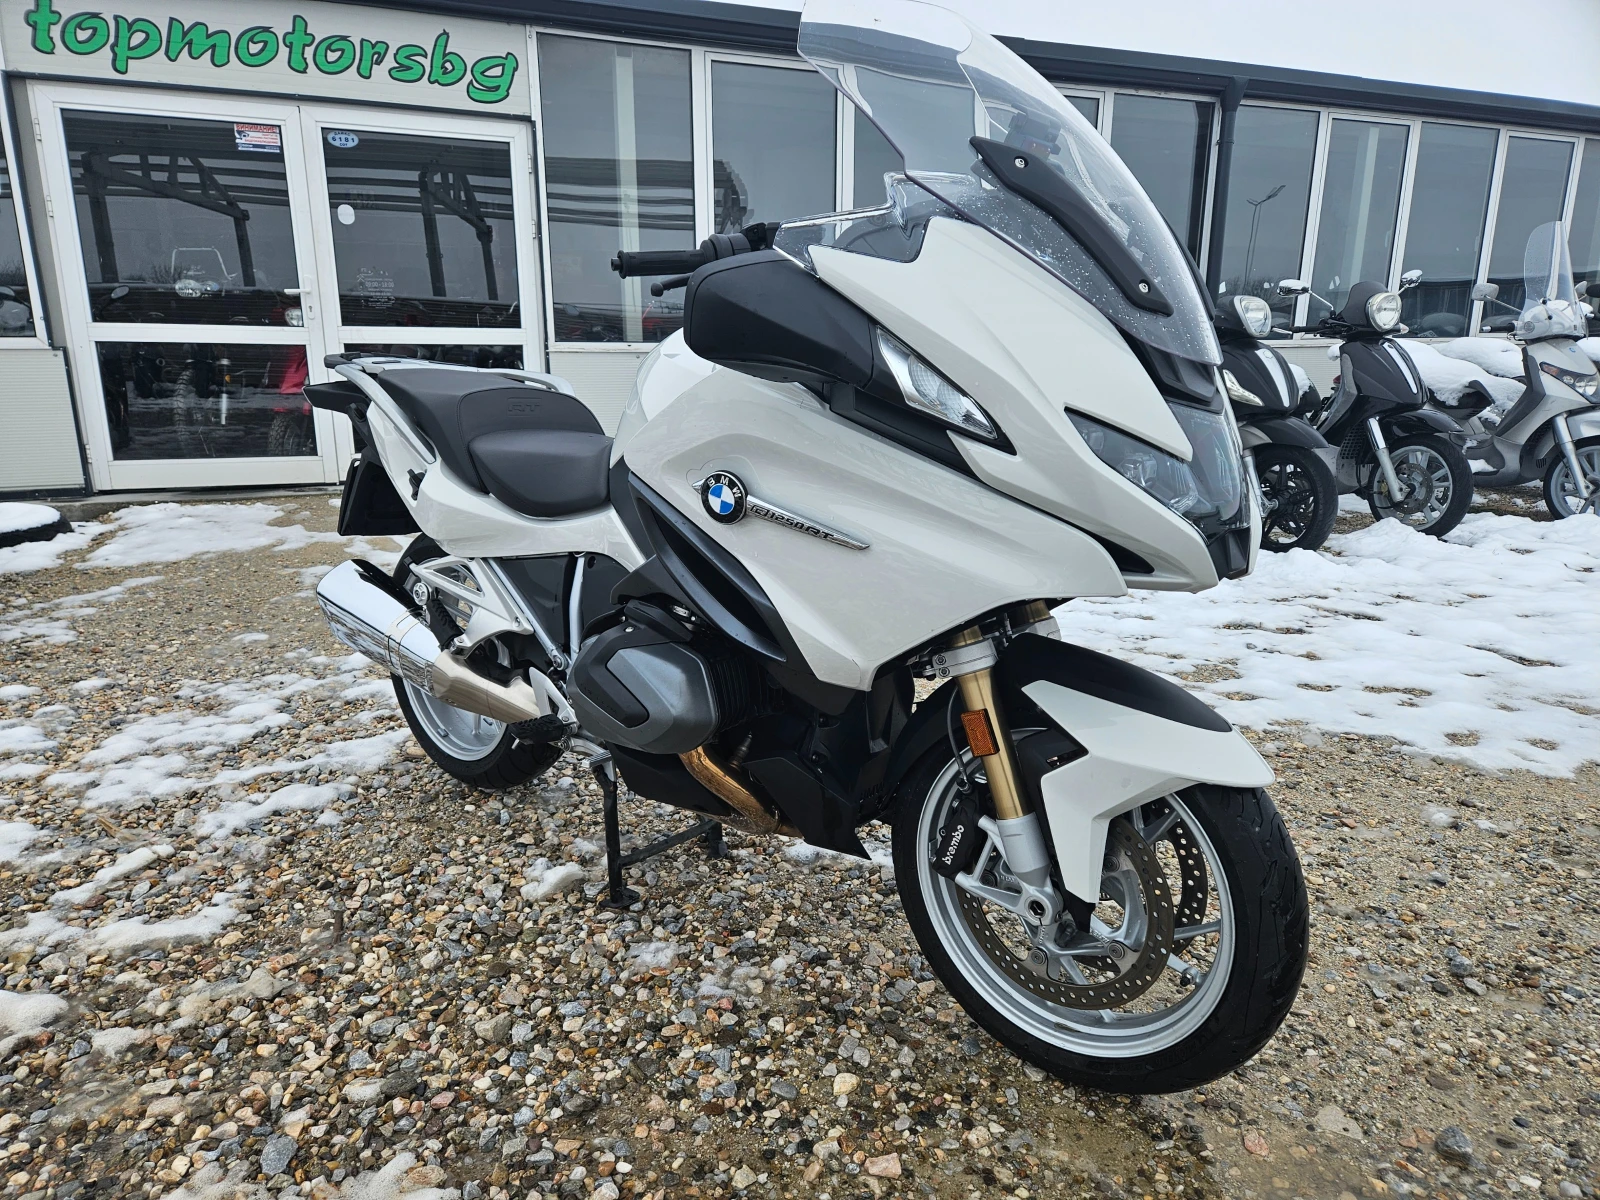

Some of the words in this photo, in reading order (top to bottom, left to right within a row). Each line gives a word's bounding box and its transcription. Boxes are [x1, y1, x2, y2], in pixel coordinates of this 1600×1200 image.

[25, 0, 519, 103] topmotorsbg
[707, 475, 742, 498] BMW
[942, 824, 965, 865] brembo
